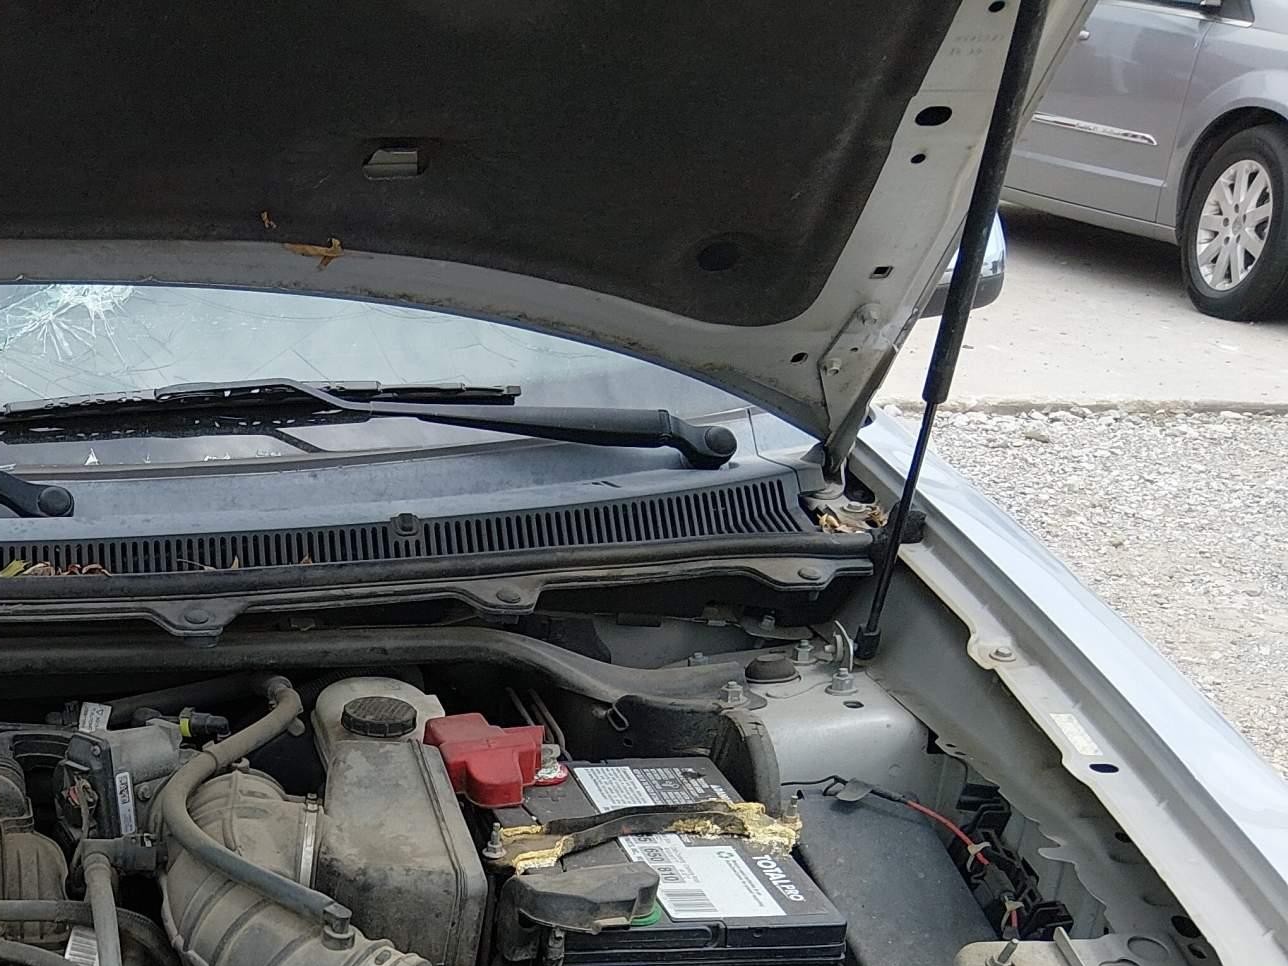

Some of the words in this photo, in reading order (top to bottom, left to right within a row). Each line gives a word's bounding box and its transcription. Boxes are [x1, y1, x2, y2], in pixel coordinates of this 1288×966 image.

[643, 848, 665, 862] 650
[657, 867, 680, 881] 810
[752, 855, 805, 902] TOTALPRO
